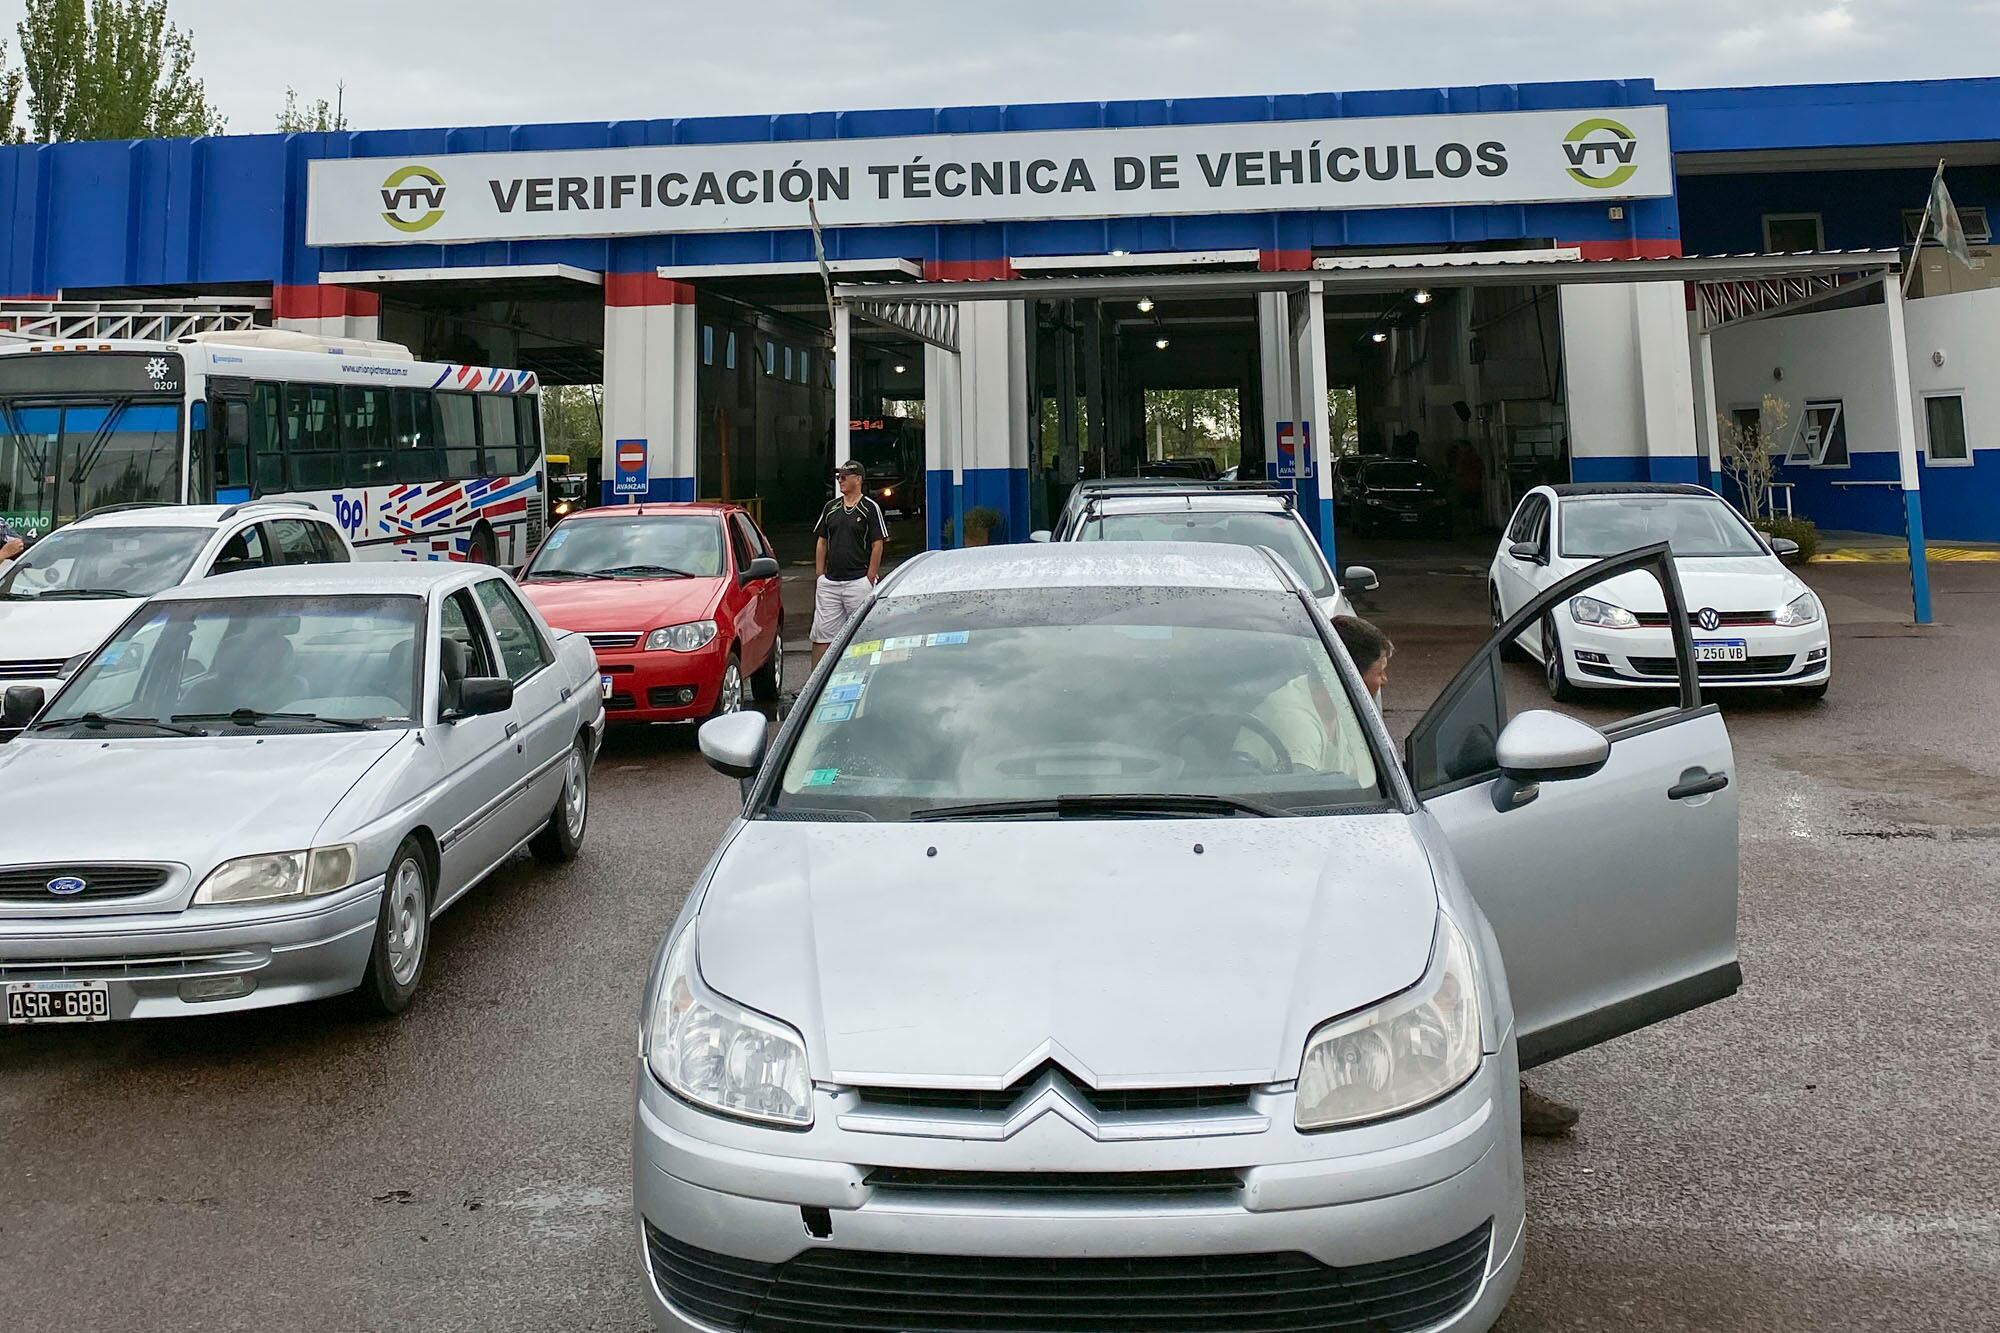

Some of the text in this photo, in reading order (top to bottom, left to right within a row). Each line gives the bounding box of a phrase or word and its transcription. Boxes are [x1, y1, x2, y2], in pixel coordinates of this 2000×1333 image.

[1562, 141, 1636, 166] VTV
[488, 139, 1509, 214] VERIFICACIÓN TÉCNICA DE VEHÍCULOS
[381, 187, 446, 211] VTV
[153, 381, 178, 391] 0201
[331, 490, 369, 540] Top!
[26, 527, 38, 539] 4
[1703, 648, 1725, 660] 250
[1729, 647, 1743, 660] VB
[12, 991, 105, 1017] ASR 688
